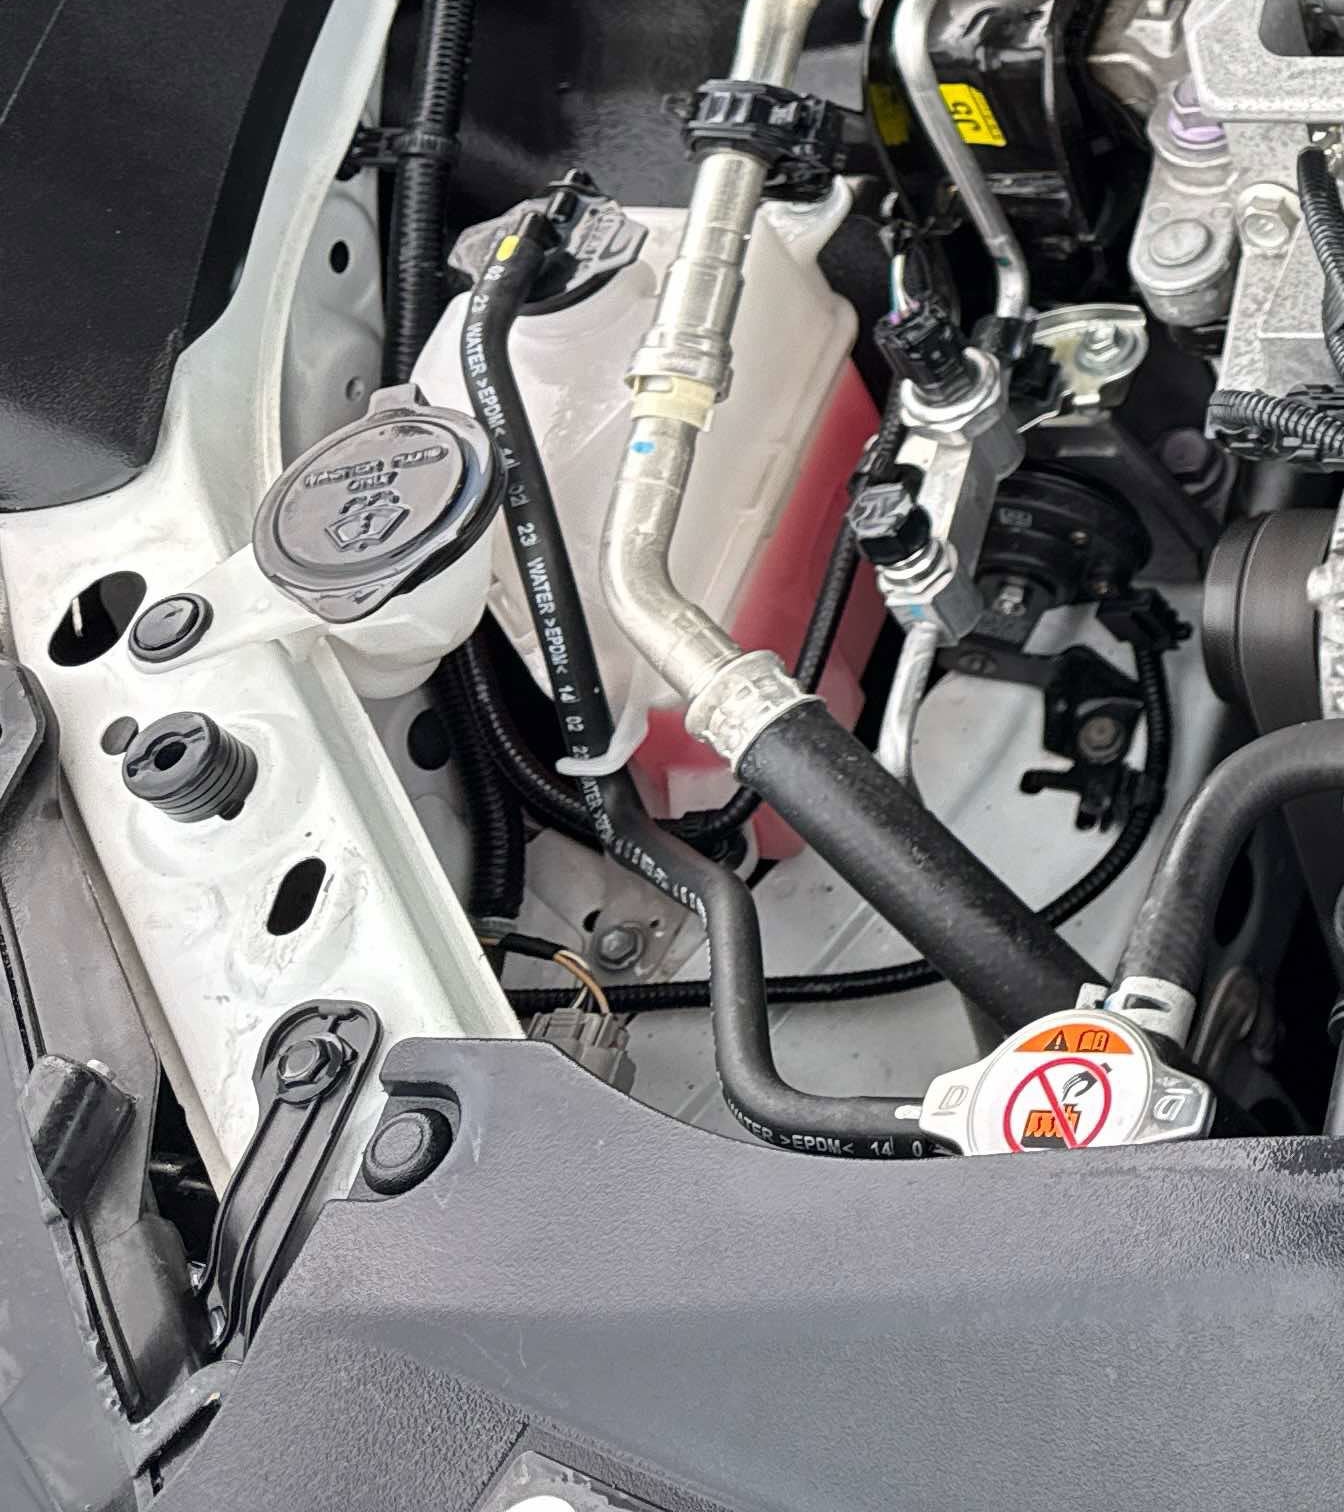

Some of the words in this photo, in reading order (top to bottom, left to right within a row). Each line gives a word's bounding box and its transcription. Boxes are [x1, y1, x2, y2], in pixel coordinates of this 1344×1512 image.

[465, 321, 488, 377] WATER
[516, 521, 537, 547] 23
[527, 556, 556, 615] WATER
[565, 715, 585, 733] 02
[779, 1134, 854, 1155] >EPDM<
